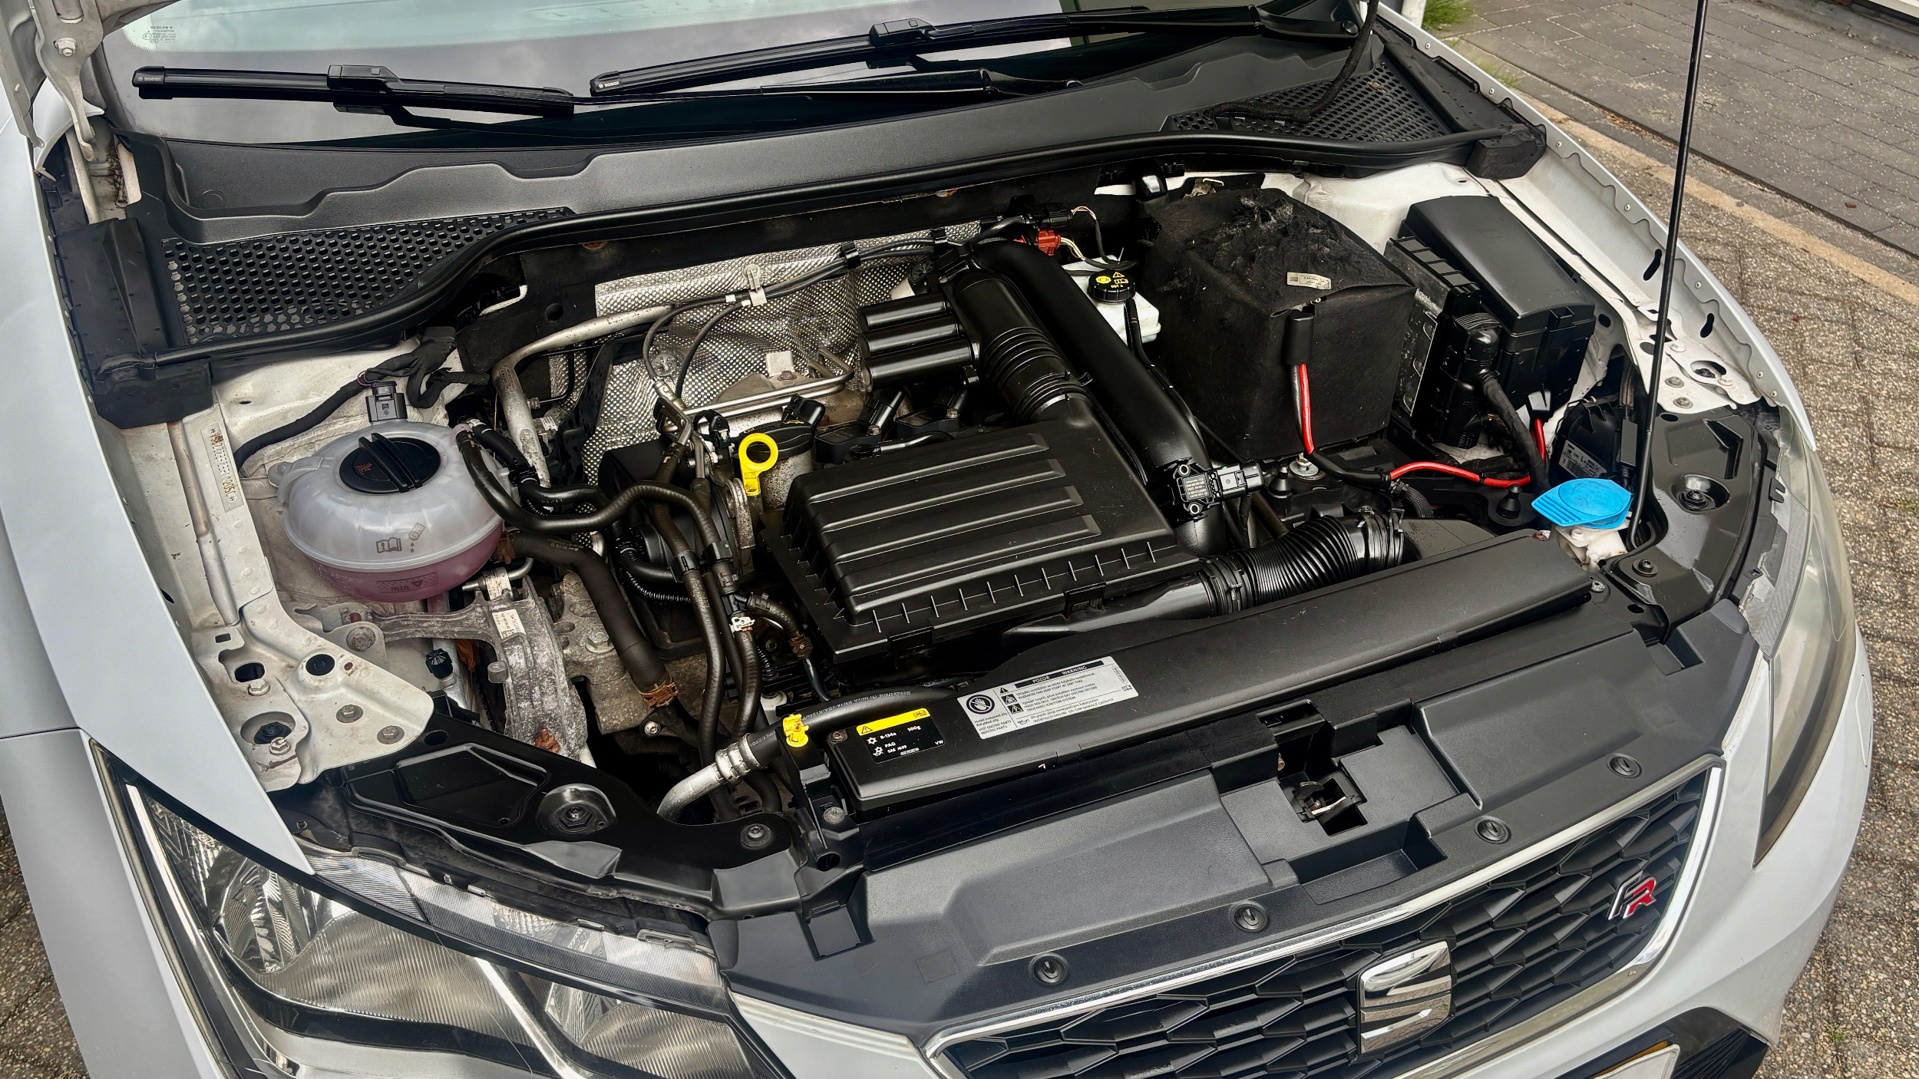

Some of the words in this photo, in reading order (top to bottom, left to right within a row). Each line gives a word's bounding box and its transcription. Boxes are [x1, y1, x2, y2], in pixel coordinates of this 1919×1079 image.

[391, 585, 409, 593] min
[1061, 666, 1087, 675] WARNING
[1608, 870, 1657, 920] FR
